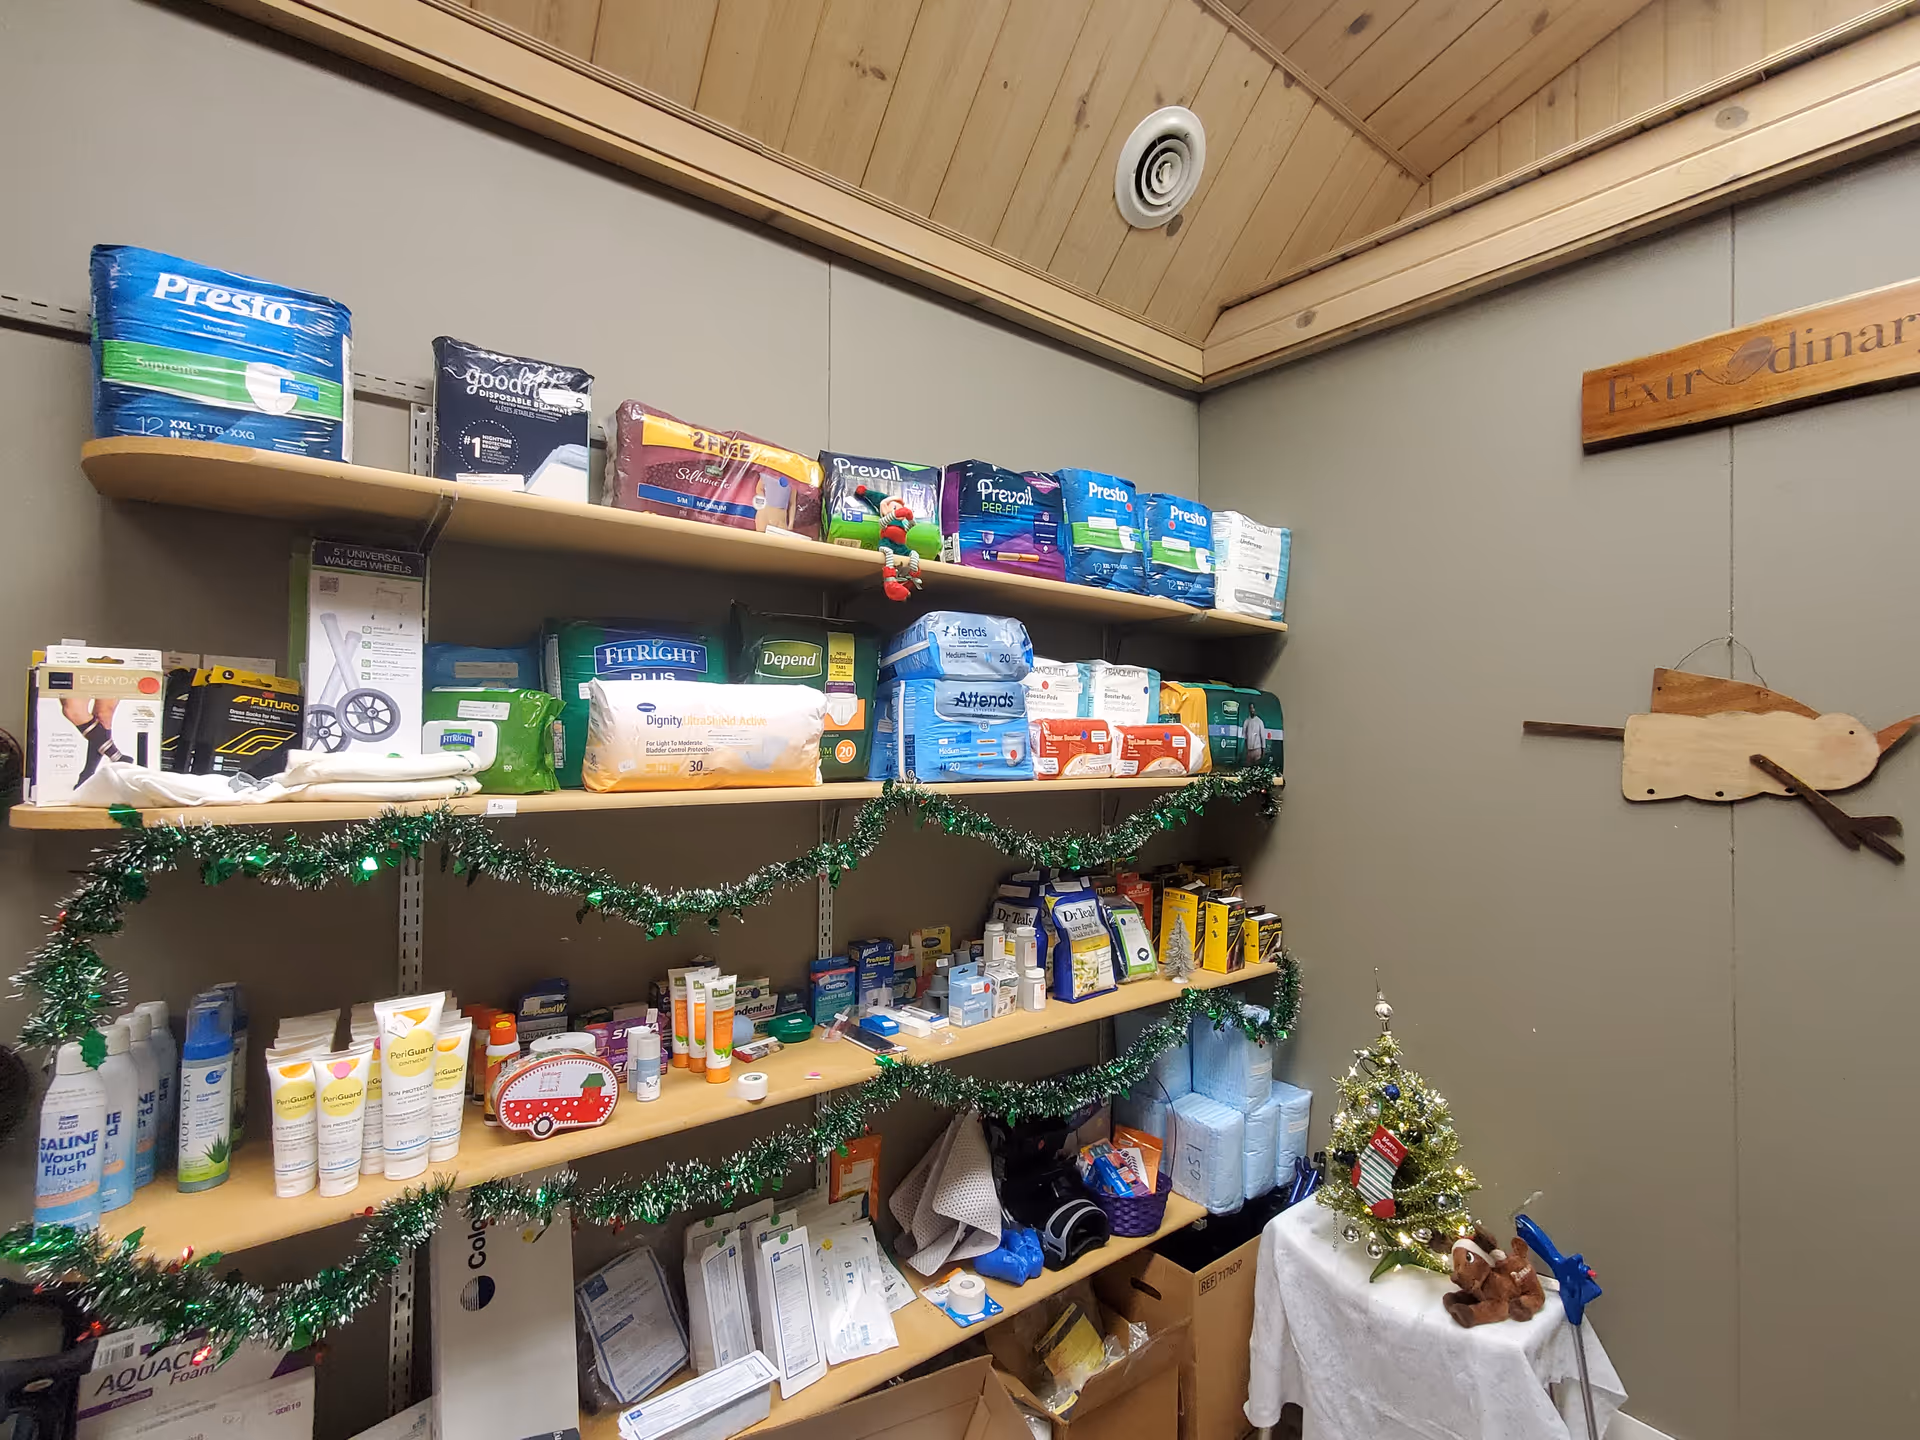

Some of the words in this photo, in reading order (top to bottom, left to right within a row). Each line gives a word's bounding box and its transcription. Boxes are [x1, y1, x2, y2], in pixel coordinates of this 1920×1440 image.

[153, 272, 292, 325] Presto
[479, 389, 532, 407] DISPOSABLE
[136, 416, 164, 435] 12
[708, 437, 751, 459] FREE
[833, 457, 901, 481] Prevail
[675, 466, 733, 490] Silhouette
[977, 478, 1033, 506] Prevail
[1088, 481, 1128, 503] Presto
[696, 500, 727, 512] MAXIMUM
[981, 501, 1018, 515] PER-FIT
[1170, 504, 1207, 527] Presto
[347, 549, 404, 565] UNIVERSAL
[982, 549, 990, 560] 14
[324, 556, 369, 570] WALKER
[369, 561, 412, 574] WHEELS
[763, 650, 816, 669] Depend
[945, 651, 966, 659] Medium
[999, 653, 1011, 663] 20
[250, 697, 300, 712] FUTURO
[954, 690, 1014, 708] Attends
[646, 714, 683, 729] Dignity
[646, 746, 667, 754] Bladder
[687, 745, 714, 753] Protection
[838, 746, 853, 758] 20
[938, 747, 960, 755] Medium
[688, 760, 704, 772] 30
[949, 762, 960, 771] 20
[997, 907, 1011, 921] Dr
[1063, 909, 1078, 922] Dr
[390, 1045, 435, 1060] PeriGuard
[434, 1064, 465, 1077] eriGuard
[276, 1091, 316, 1106] PeriGuard
[323, 1088, 363, 1103] PeriGuard
[40, 1129, 99, 1151] SALINE
[40, 1143, 97, 1164] Wound
[45, 1160, 87, 1177] Flush
[844, 1261, 852, 1269] 8
[846, 1272, 854, 1285] Fr
[1200, 1275, 1216, 1293] REF
[1218, 1259, 1243, 1283] 7176DP
[94, 1346, 213, 1397] AQUAC
[169, 1363, 216, 1387] Foam
